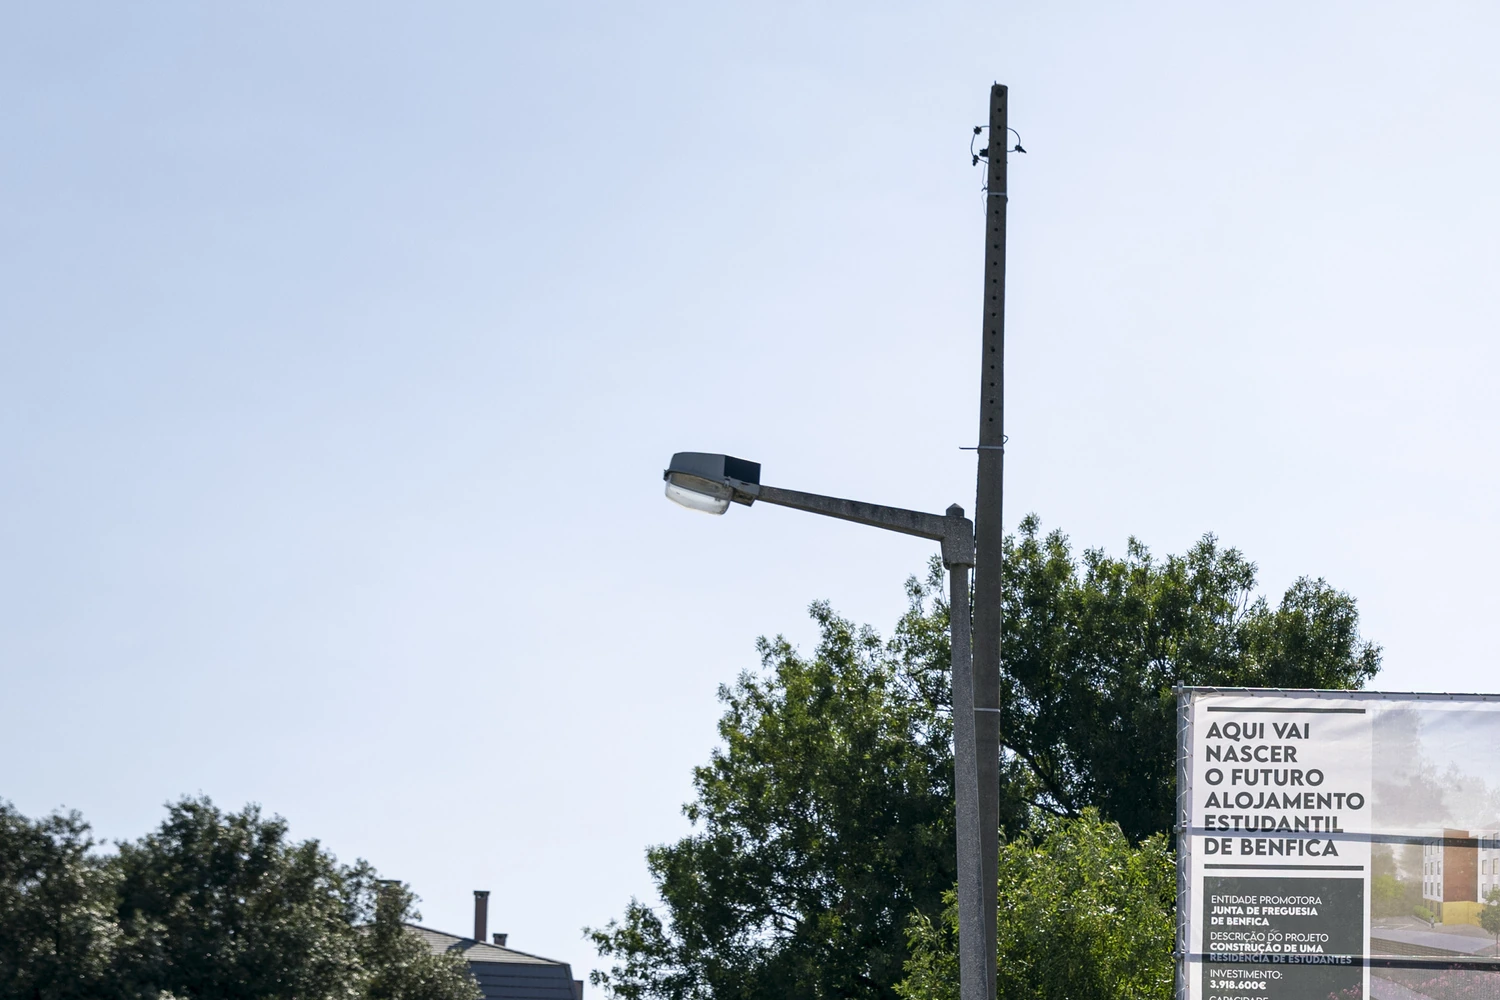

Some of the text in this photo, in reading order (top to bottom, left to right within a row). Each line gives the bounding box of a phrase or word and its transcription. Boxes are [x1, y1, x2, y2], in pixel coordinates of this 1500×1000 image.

[1205, 721, 1310, 742] AQUI VAI
[1205, 744, 1298, 763] NASCER
[1204, 768, 1324, 786] O FUTURO
[1204, 791, 1365, 810] ALOJAMENTO
[1204, 814, 1344, 833] ESTUDANTIL
[1204, 837, 1339, 857] DE BENFICA
[1211, 895, 1323, 905] ENTIDADE PROMOTORA
[1211, 906, 1318, 916] JUNTA DE FREGUESIA
[1210, 917, 1270, 926] DE BENFICA
[1210, 931, 1329, 943] DESCRIÇÃO DO PROJETO
[1210, 942, 1324, 954] CONSTRUÇÃO DE UMA
[1209, 952, 1352, 964] RESIDÊNCIA DE ESTUDANTES
[1210, 970, 1283, 980] INVESTIMENTO:
[1210, 980, 1267, 990] 3.918.600€
